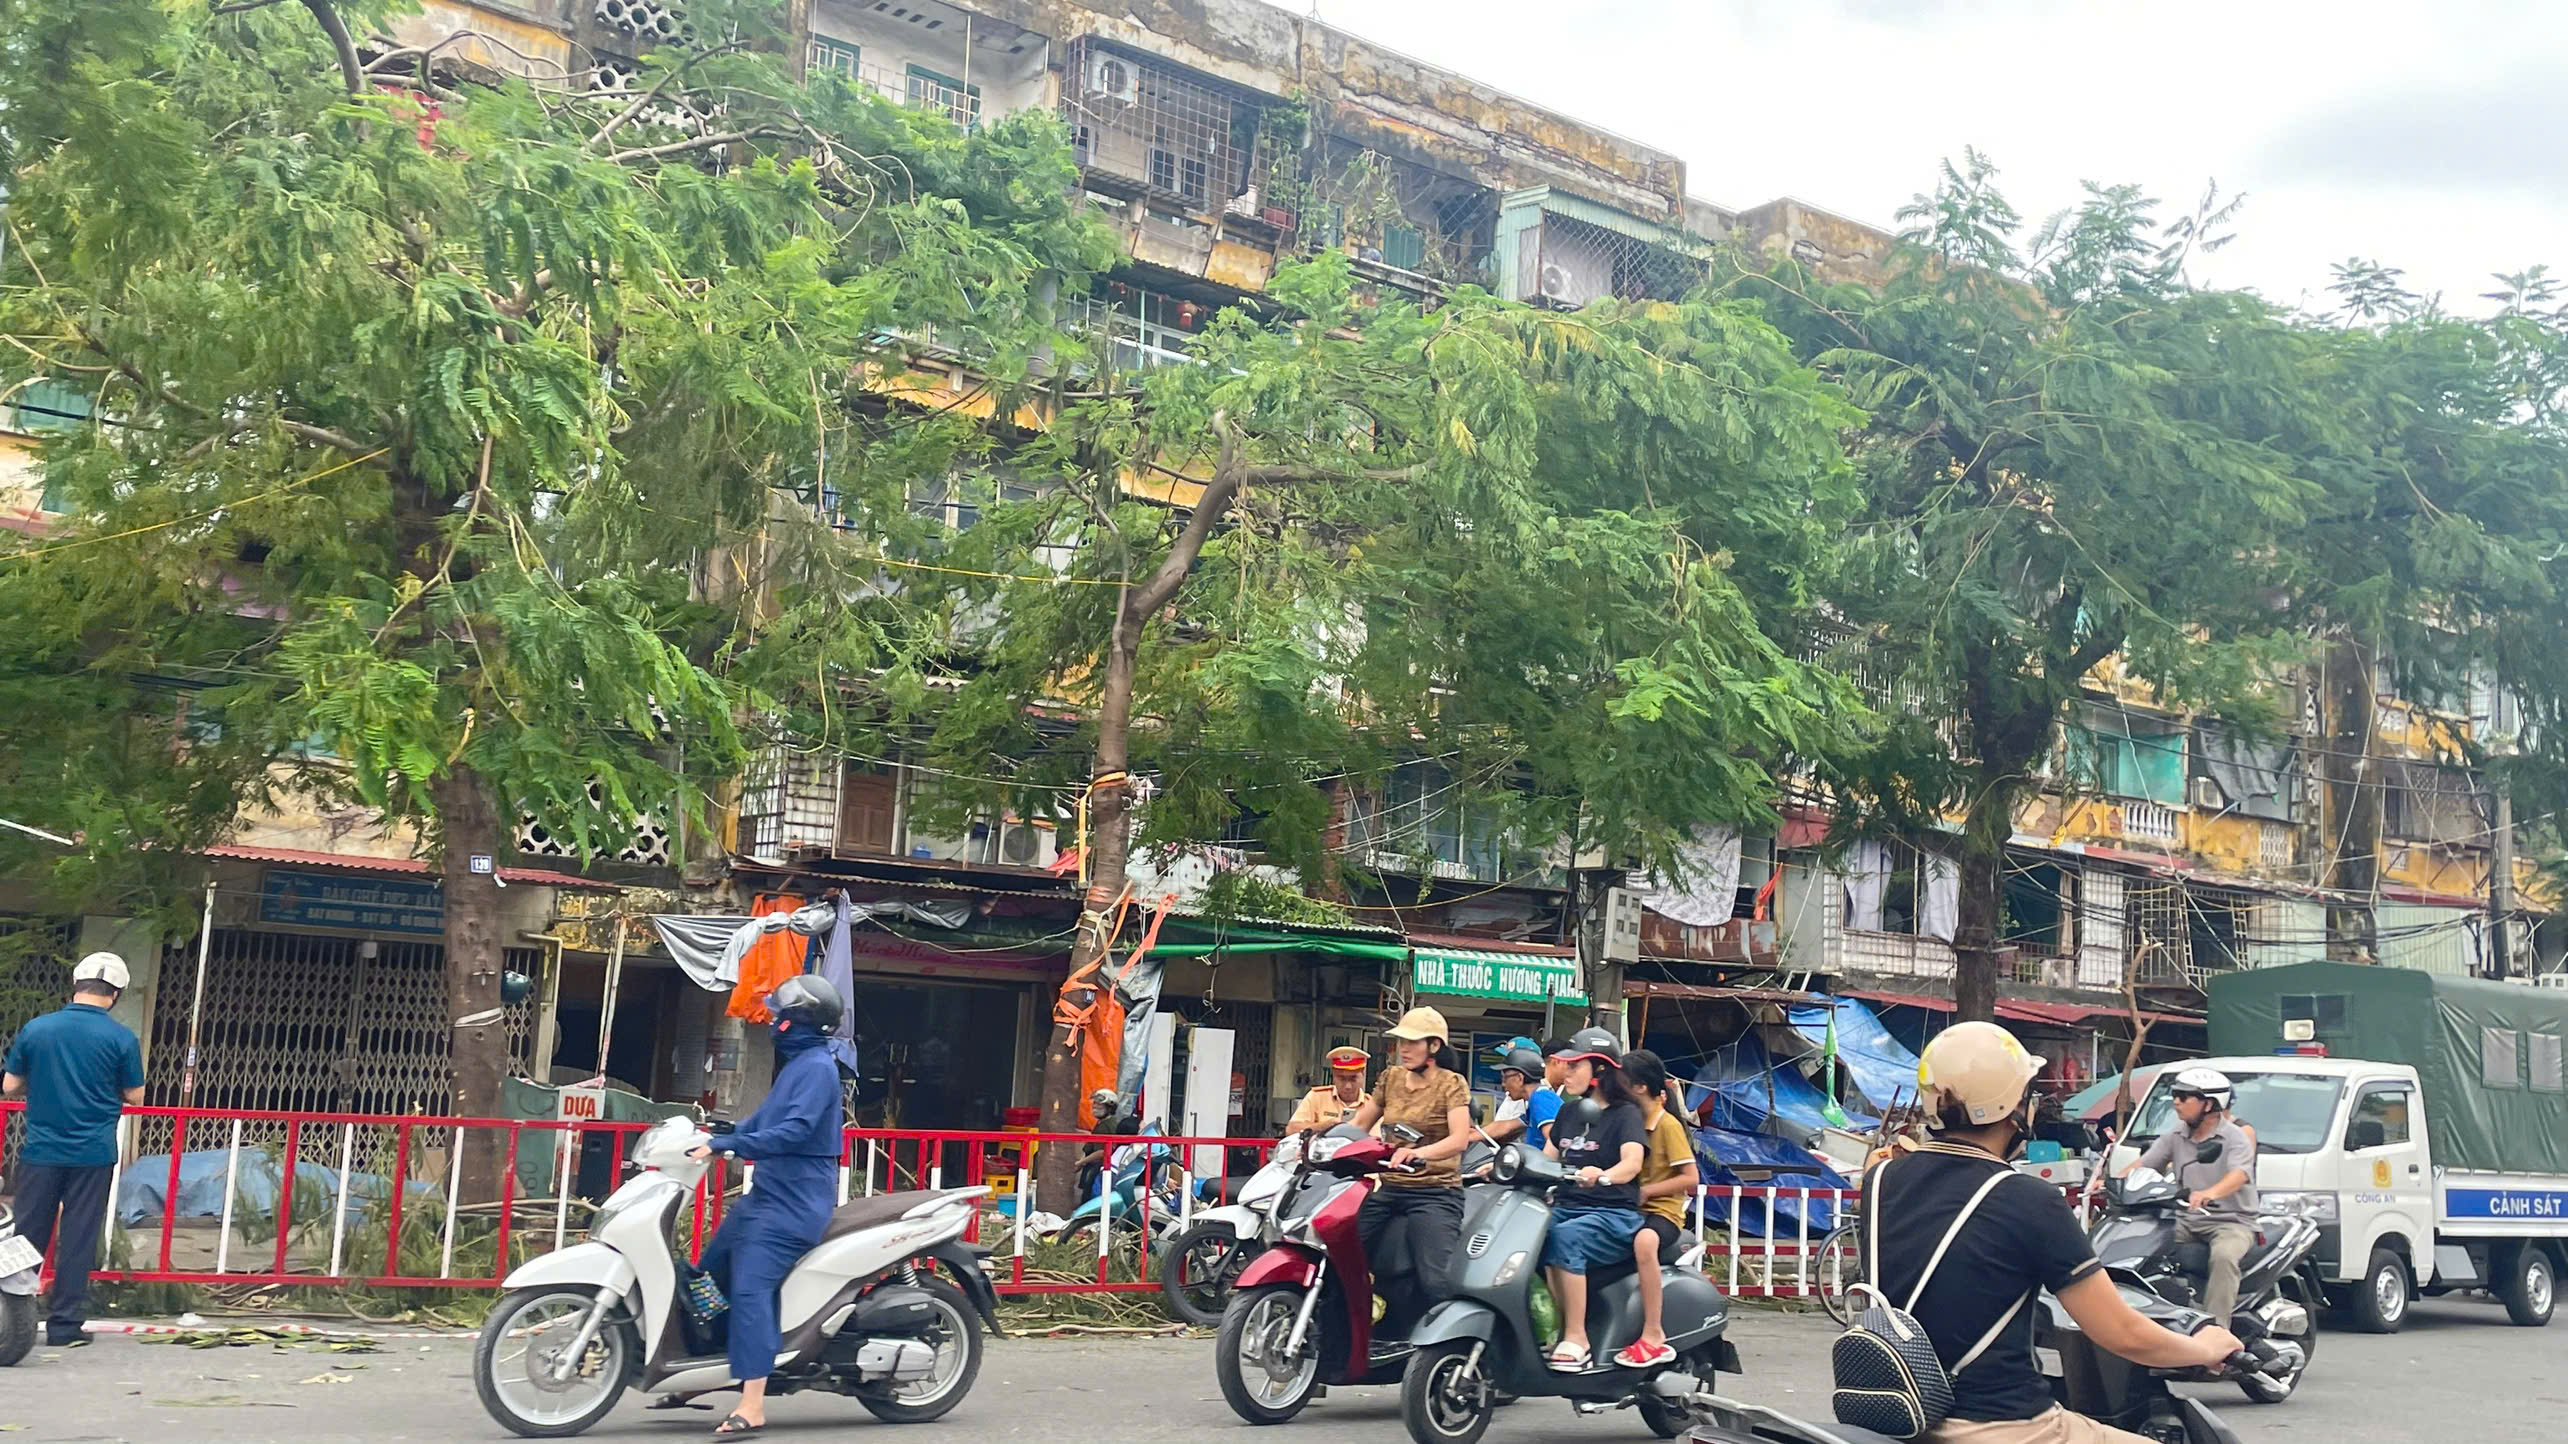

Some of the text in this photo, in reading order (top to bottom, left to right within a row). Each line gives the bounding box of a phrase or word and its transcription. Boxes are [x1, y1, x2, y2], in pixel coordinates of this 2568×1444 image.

[1418, 958, 1583, 998] NHÀ THUỐC HƯƠNG GIAN
[563, 1095, 596, 1117] DƯA
[2355, 1192, 2396, 1203] CÔNG AN
[2489, 1191, 2562, 1215] CẢNH SÁT
